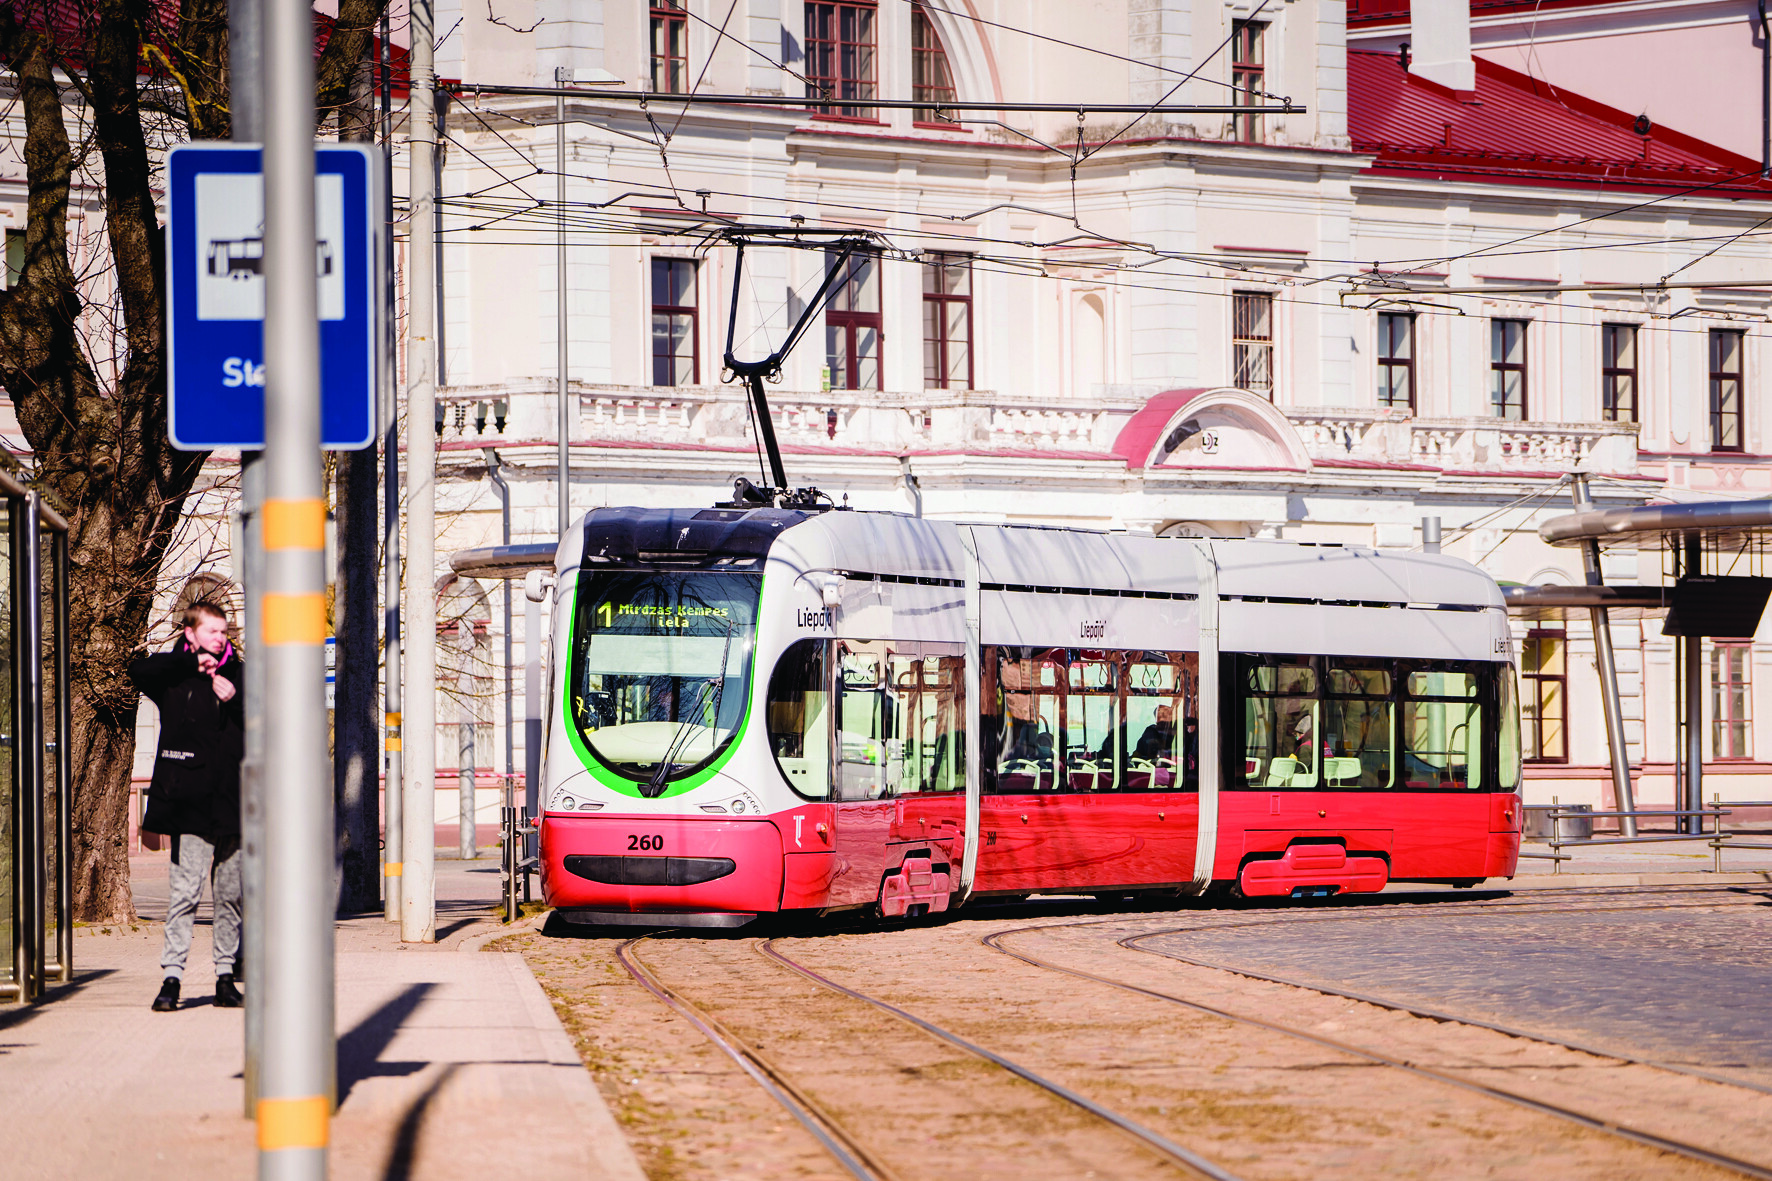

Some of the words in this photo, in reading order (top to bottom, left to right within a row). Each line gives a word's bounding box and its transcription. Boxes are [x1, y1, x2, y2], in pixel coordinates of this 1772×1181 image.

[597, 601, 612, 628] 1
[618, 603, 673, 616] Mirdzas
[658, 617, 690, 628] iela
[627, 834, 664, 851] 260
[986, 831, 997, 846] 260
